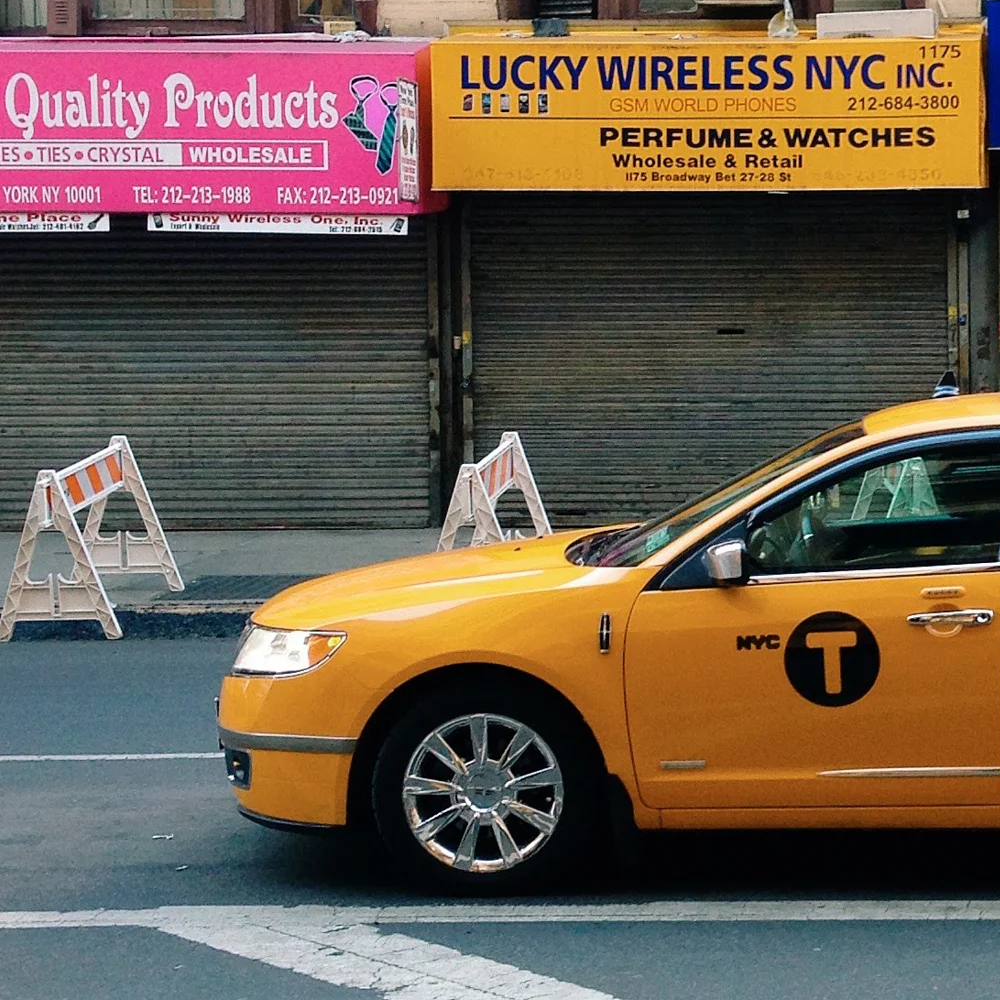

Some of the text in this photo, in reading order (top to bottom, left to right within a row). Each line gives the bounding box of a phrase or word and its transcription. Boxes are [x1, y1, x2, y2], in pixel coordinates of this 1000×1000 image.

[919, 44, 962, 60] 1175
[461, 54, 954, 91] LUCKY WIRELESS NYC INC.
[4, 72, 340, 140] Quality Products
[609, 96, 797, 113] GSM WORLD PHONES
[848, 95, 960, 111] 212-684-3800
[600, 126, 936, 148] PERFUME & WATCHES
[36, 147, 71, 163] TIES
[87, 147, 164, 164] CRYSTAL
[189, 147, 313, 164] WHOLESALE
[613, 153, 803, 169] Wholesale & Retail
[625, 171, 792, 184] 1175 Broadway Bet 27-28 St
[2, 186, 101, 204] YORK NY 10001
[132, 186, 251, 204] TEL: 212-213-1988
[277, 186, 399, 205] FAX: 212-213-0921
[169, 213, 220, 224] Sunny
[227, 213, 301, 223] Wireless
[736, 634, 781, 651] NYC
[805, 630, 857, 695] T
